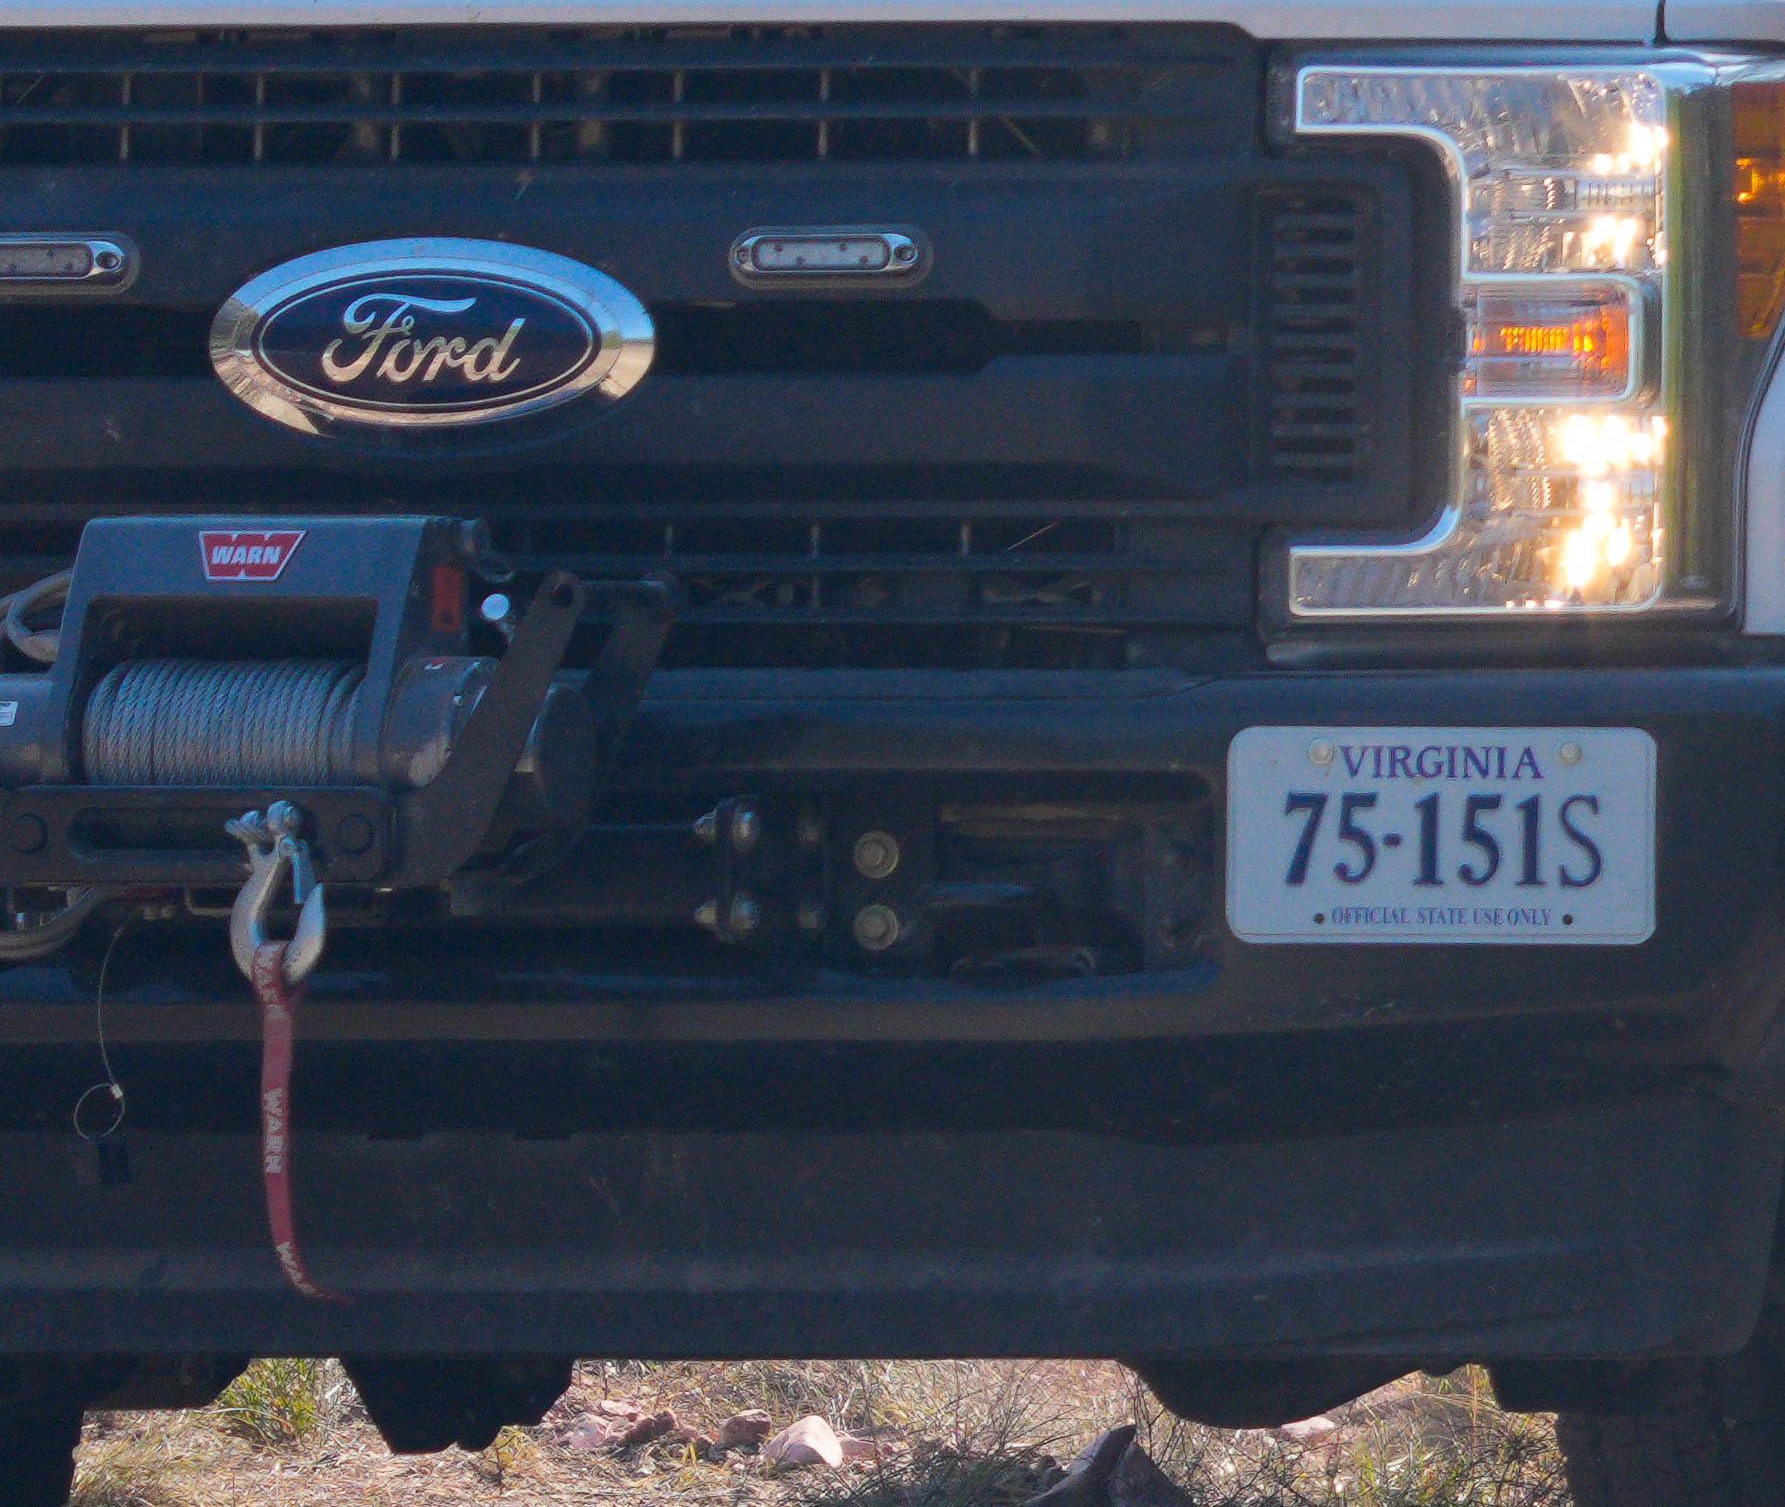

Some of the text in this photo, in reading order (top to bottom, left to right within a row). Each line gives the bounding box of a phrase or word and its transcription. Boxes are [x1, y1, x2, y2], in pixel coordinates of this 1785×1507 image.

[322, 293, 526, 381] Ford
[211, 545, 281, 565] WARN
[1339, 745, 1542, 780] VIRGINIA
[1284, 793, 1602, 889] 75-151S
[1331, 907, 1551, 926] OFFICIAL STATE USE ONLY
[264, 1089, 286, 1174] WARN
